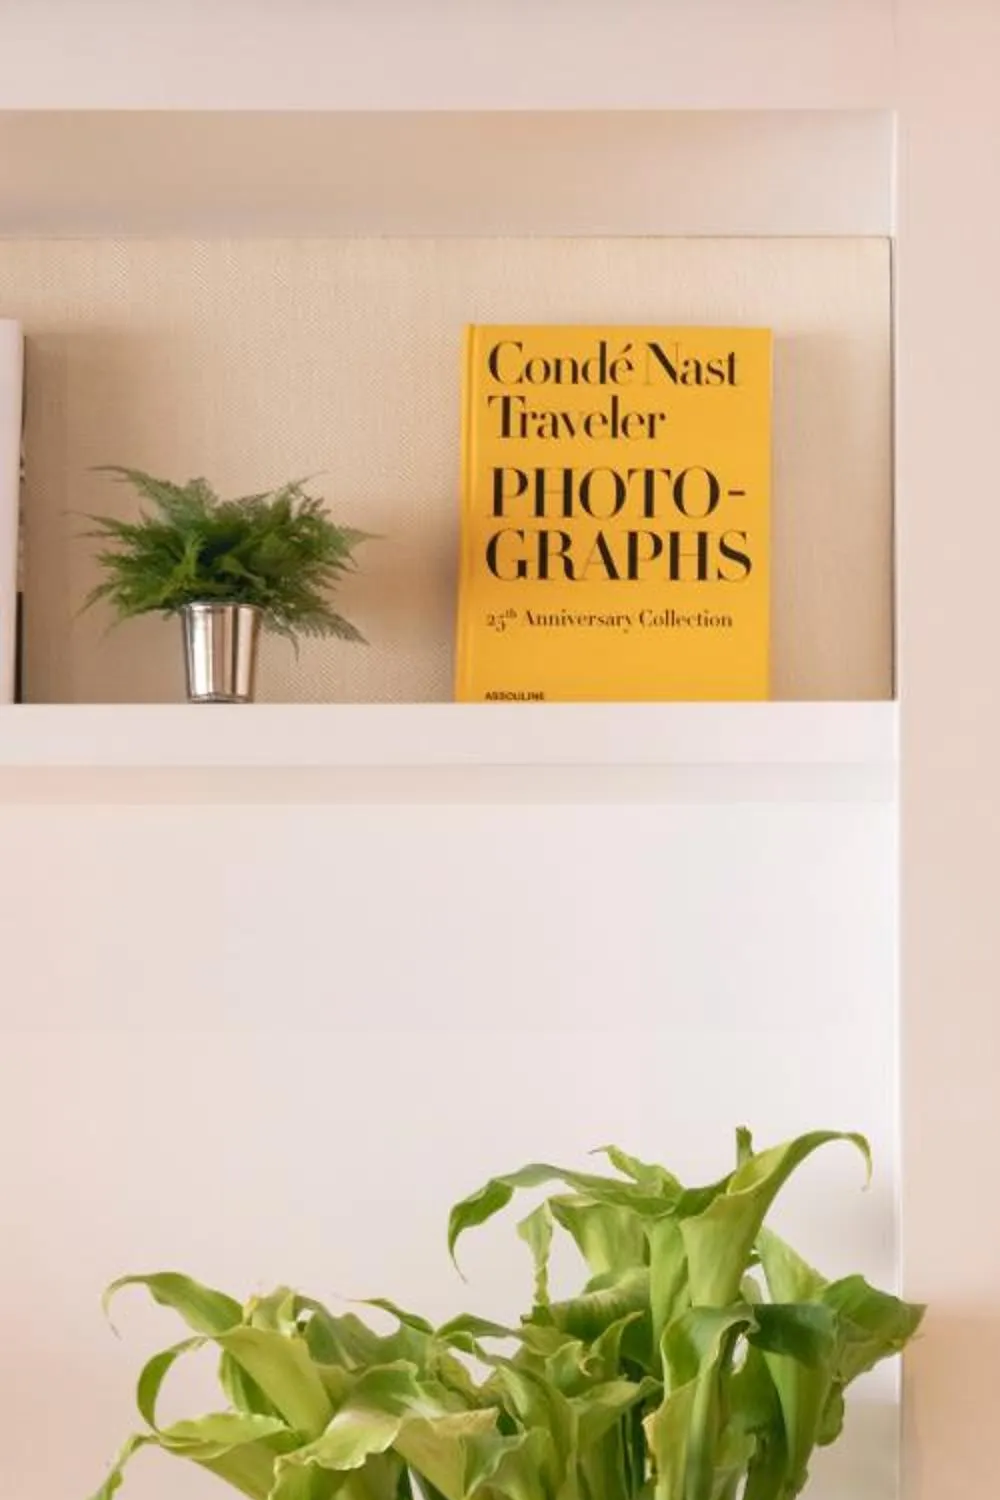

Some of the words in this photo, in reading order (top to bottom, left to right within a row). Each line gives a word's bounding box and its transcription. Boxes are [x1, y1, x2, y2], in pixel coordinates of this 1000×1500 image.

[487, 340, 635, 387] Condé
[645, 341, 742, 387] Nast
[486, 394, 667, 439] Traveler
[486, 465, 746, 521] PHOTO-
[485, 527, 753, 583] GRAPHS
[525, 608, 633, 634] Anniversary
[638, 608, 734, 628] Collection
